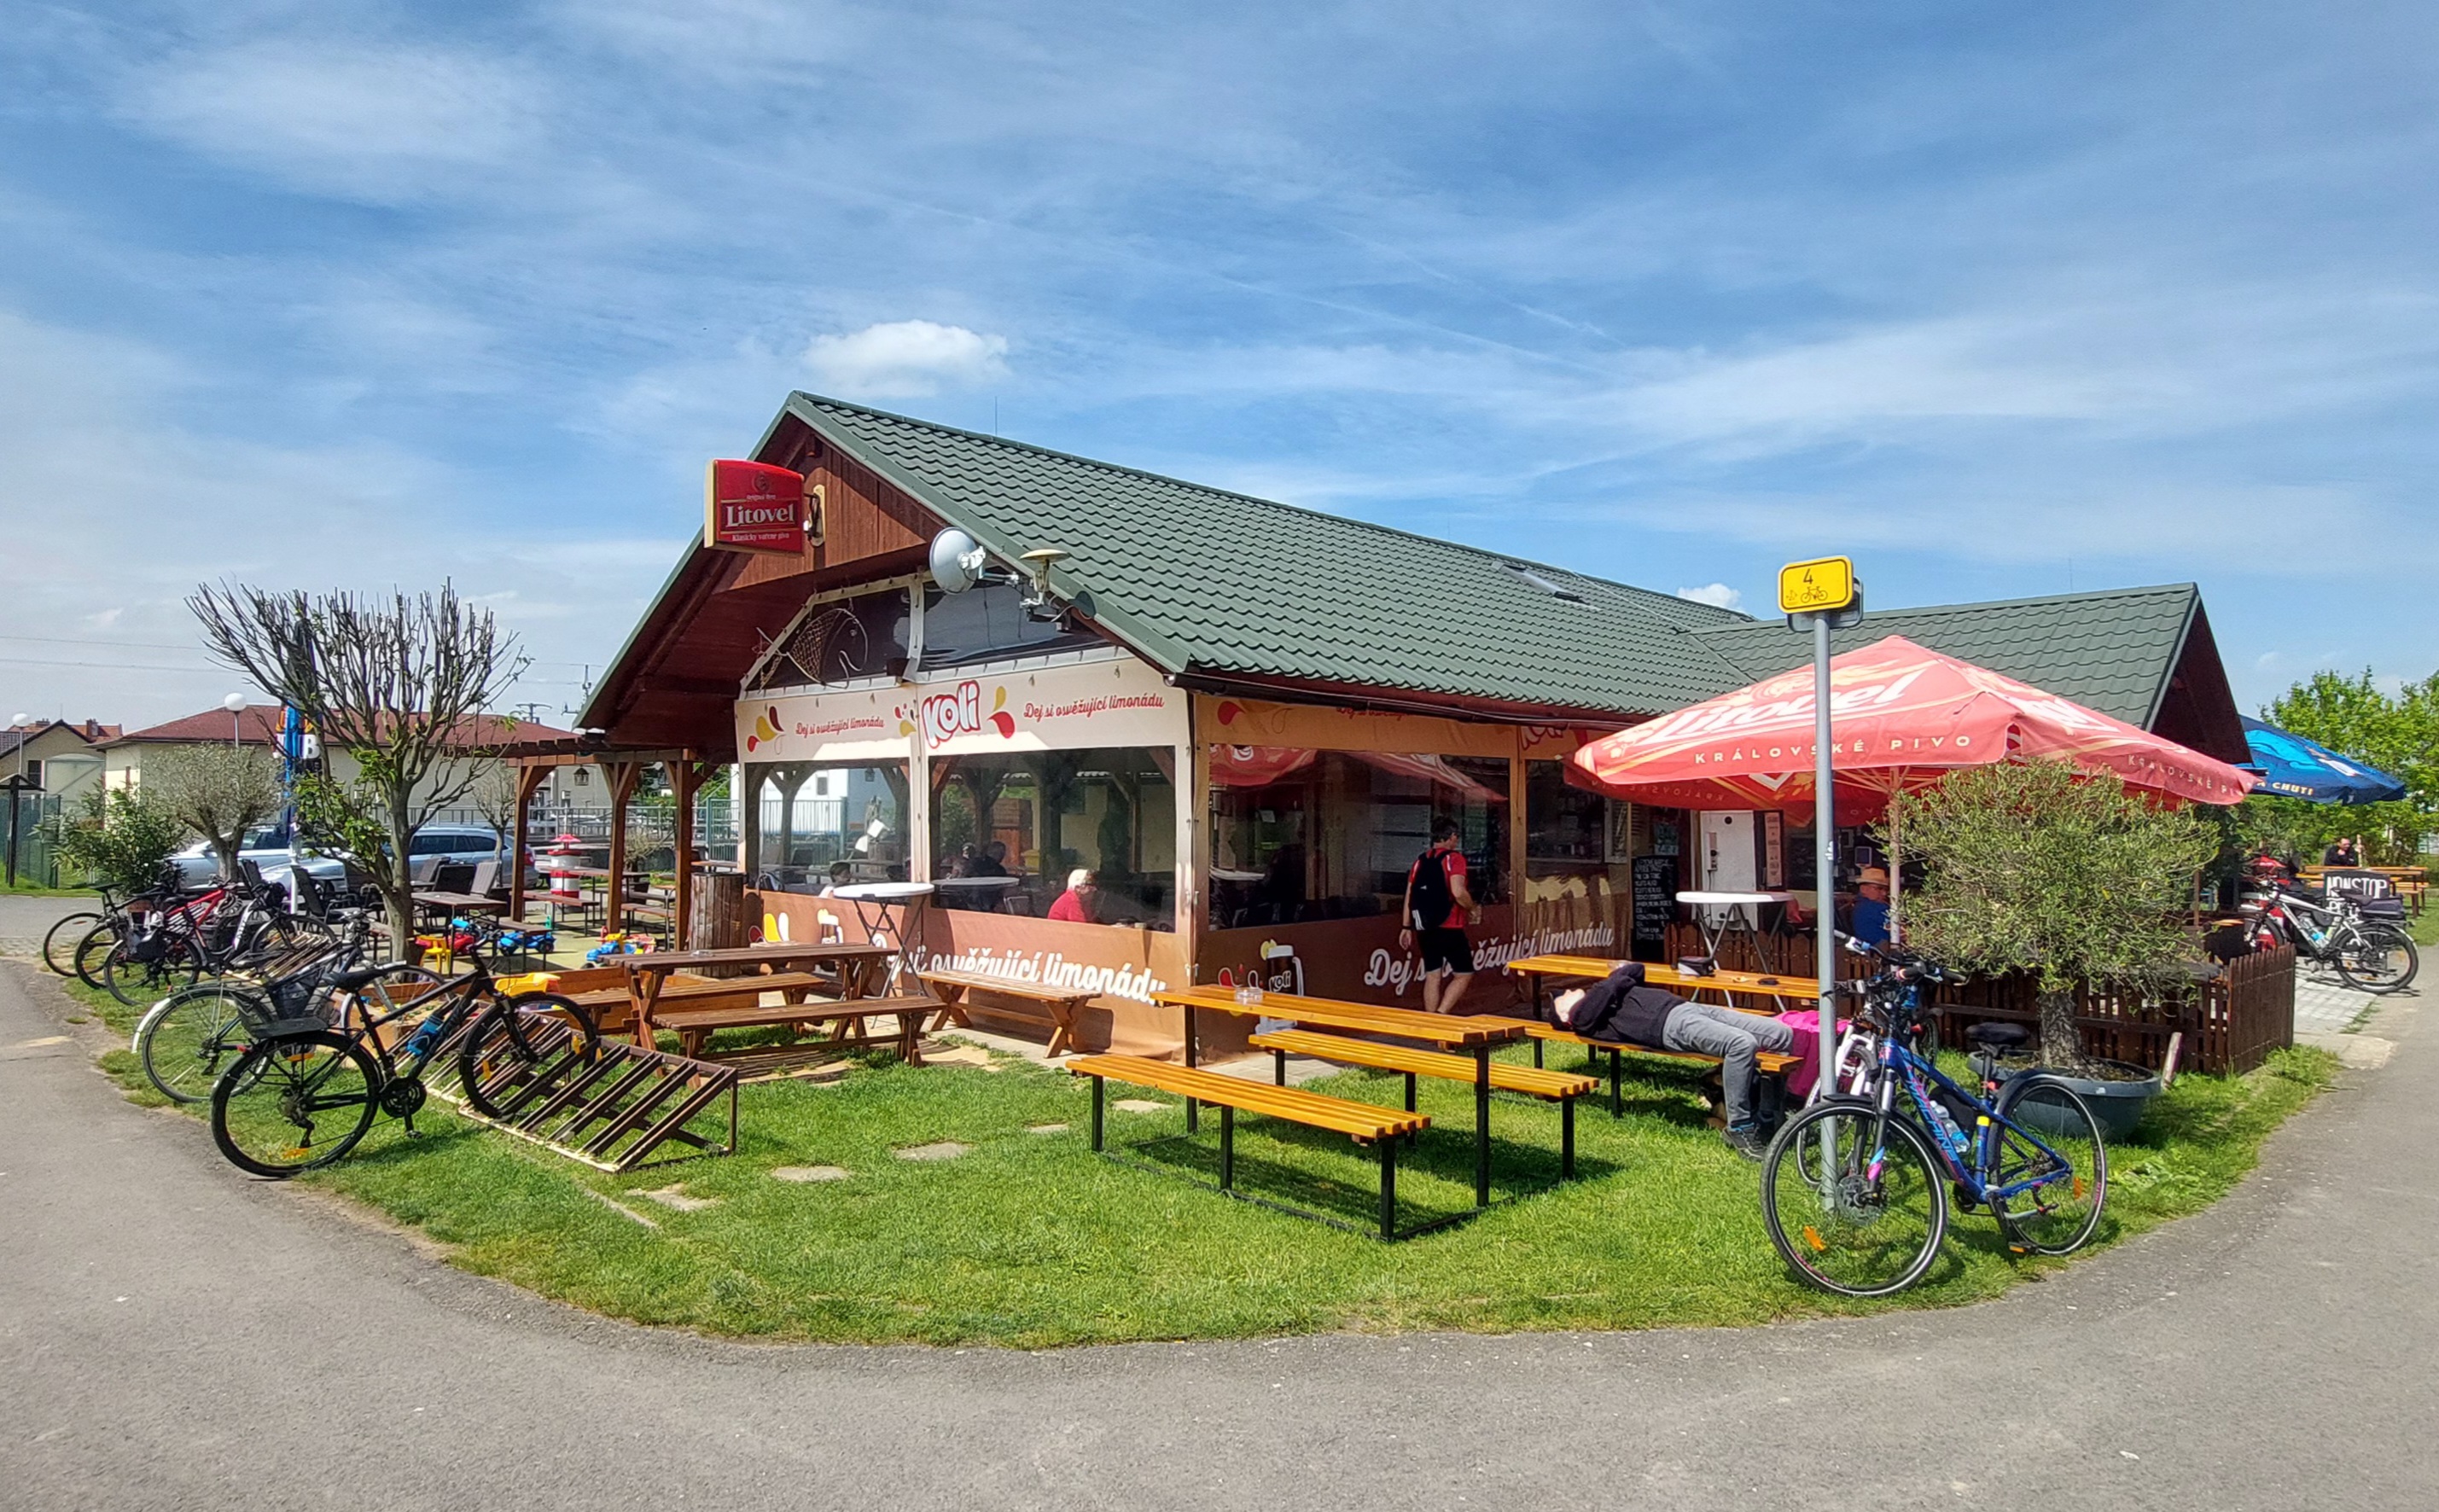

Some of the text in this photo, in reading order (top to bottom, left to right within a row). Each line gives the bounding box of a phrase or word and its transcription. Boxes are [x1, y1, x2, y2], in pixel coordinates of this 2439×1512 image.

[725, 503, 795, 527] Litovel
[1802, 568, 1813, 584] 4
[1023, 693, 1166, 723] Dej si osvěžující limonádu
[1890, 735, 1970, 751] PIVO
[1364, 949, 1412, 996] Dej
[1539, 922, 1614, 954] limonádu
[1043, 952, 1167, 1006] limonádu
